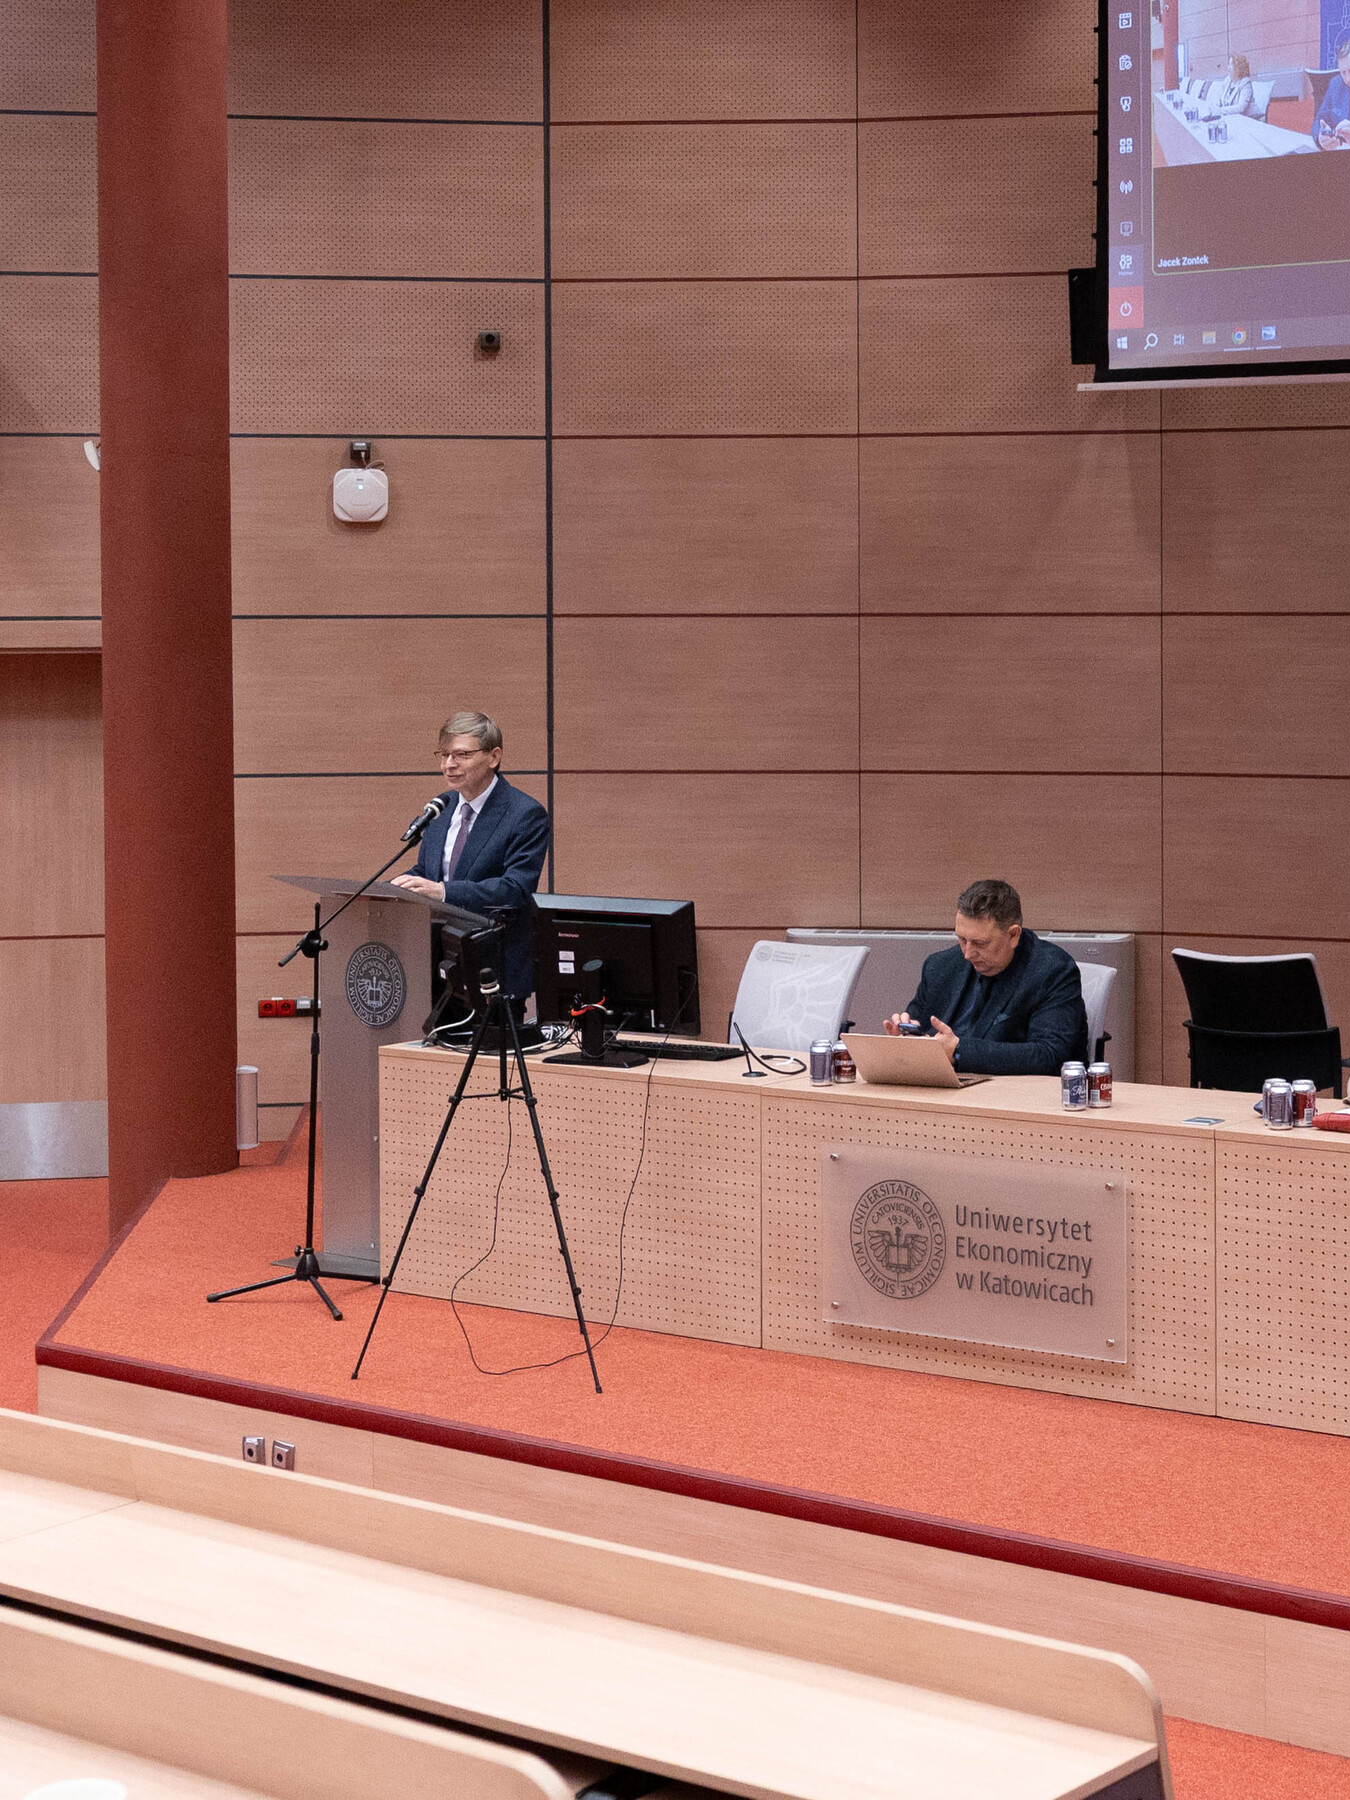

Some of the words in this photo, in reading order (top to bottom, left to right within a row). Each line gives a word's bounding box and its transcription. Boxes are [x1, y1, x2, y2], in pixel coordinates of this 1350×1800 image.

[1157, 257, 1181, 268] Jacek
[1182, 254, 1209, 266] Zontek
[853, 1183, 921, 1235] UNIVERSITATIS
[871, 1202, 924, 1230] CATOVICIENSIS
[887, 1214, 909, 1227] 1937
[955, 1204, 1092, 1243] Uniwersytet
[854, 1241, 896, 1295] SIGILLUM
[901, 1201, 944, 1297] OECONOMICAE
[955, 1236, 1092, 1279] Ekonomiczny
[955, 1272, 974, 1290] w
[980, 1271, 1094, 1306] Katowicach
